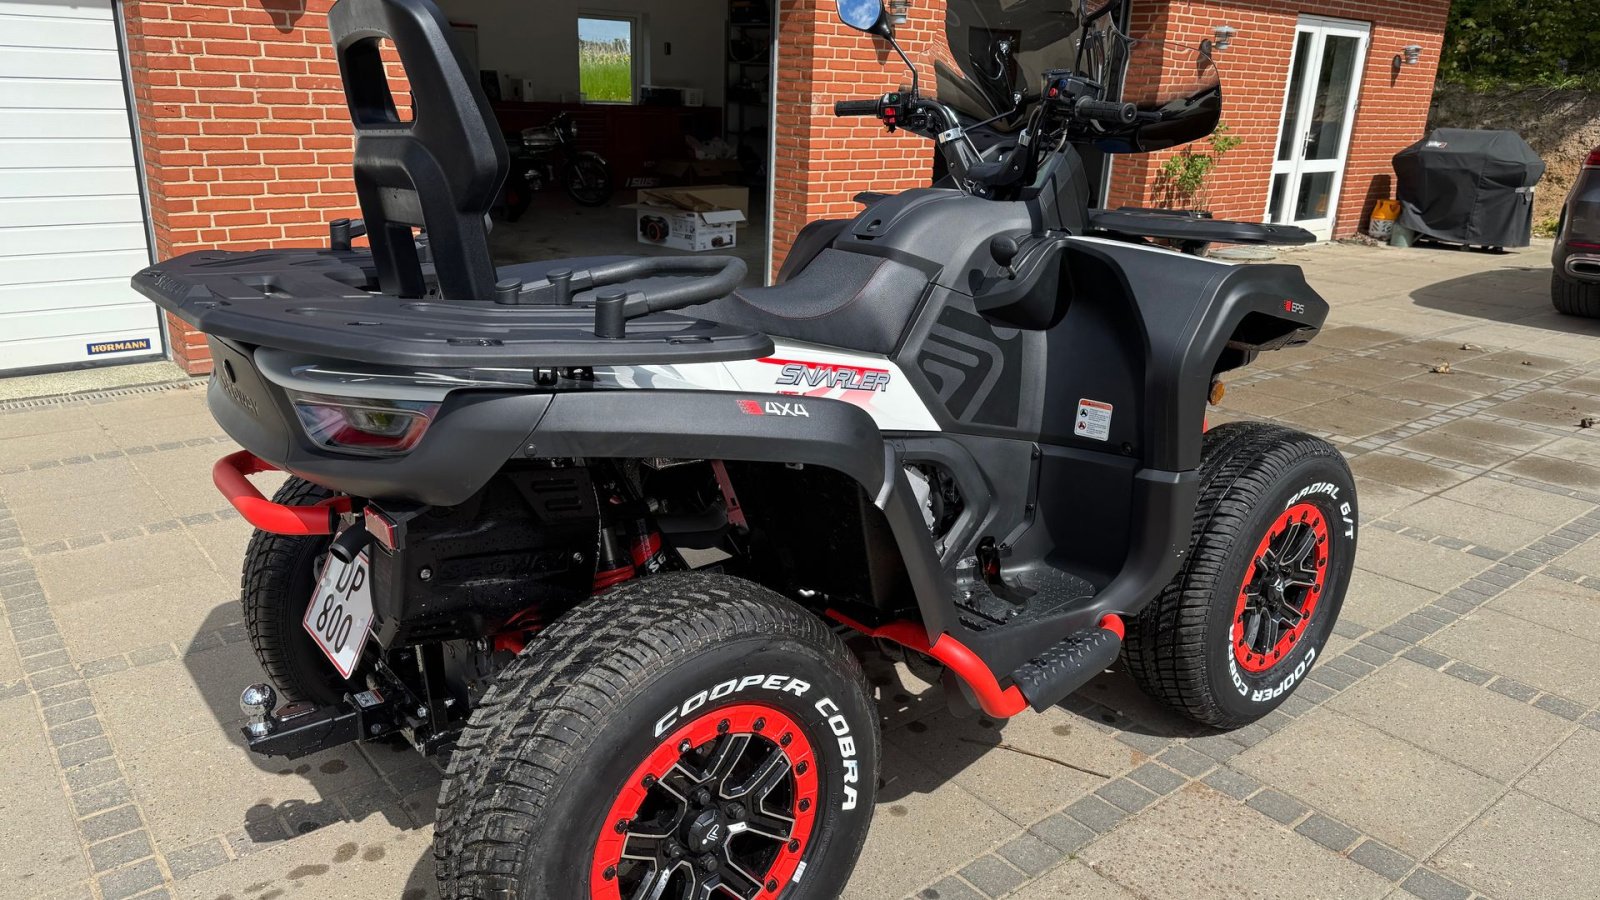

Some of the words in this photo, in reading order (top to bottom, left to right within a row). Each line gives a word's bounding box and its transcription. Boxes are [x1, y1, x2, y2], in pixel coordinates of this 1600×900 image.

[1292, 302, 1305, 314] EPS
[776, 364, 891, 392] SNARLER
[1340, 502, 1353, 540] G/T
[316, 593, 352, 654] 800
[1251, 647, 1316, 702] COOPER
[654, 674, 811, 738] COOPER
[814, 697, 859, 811] COBRA
